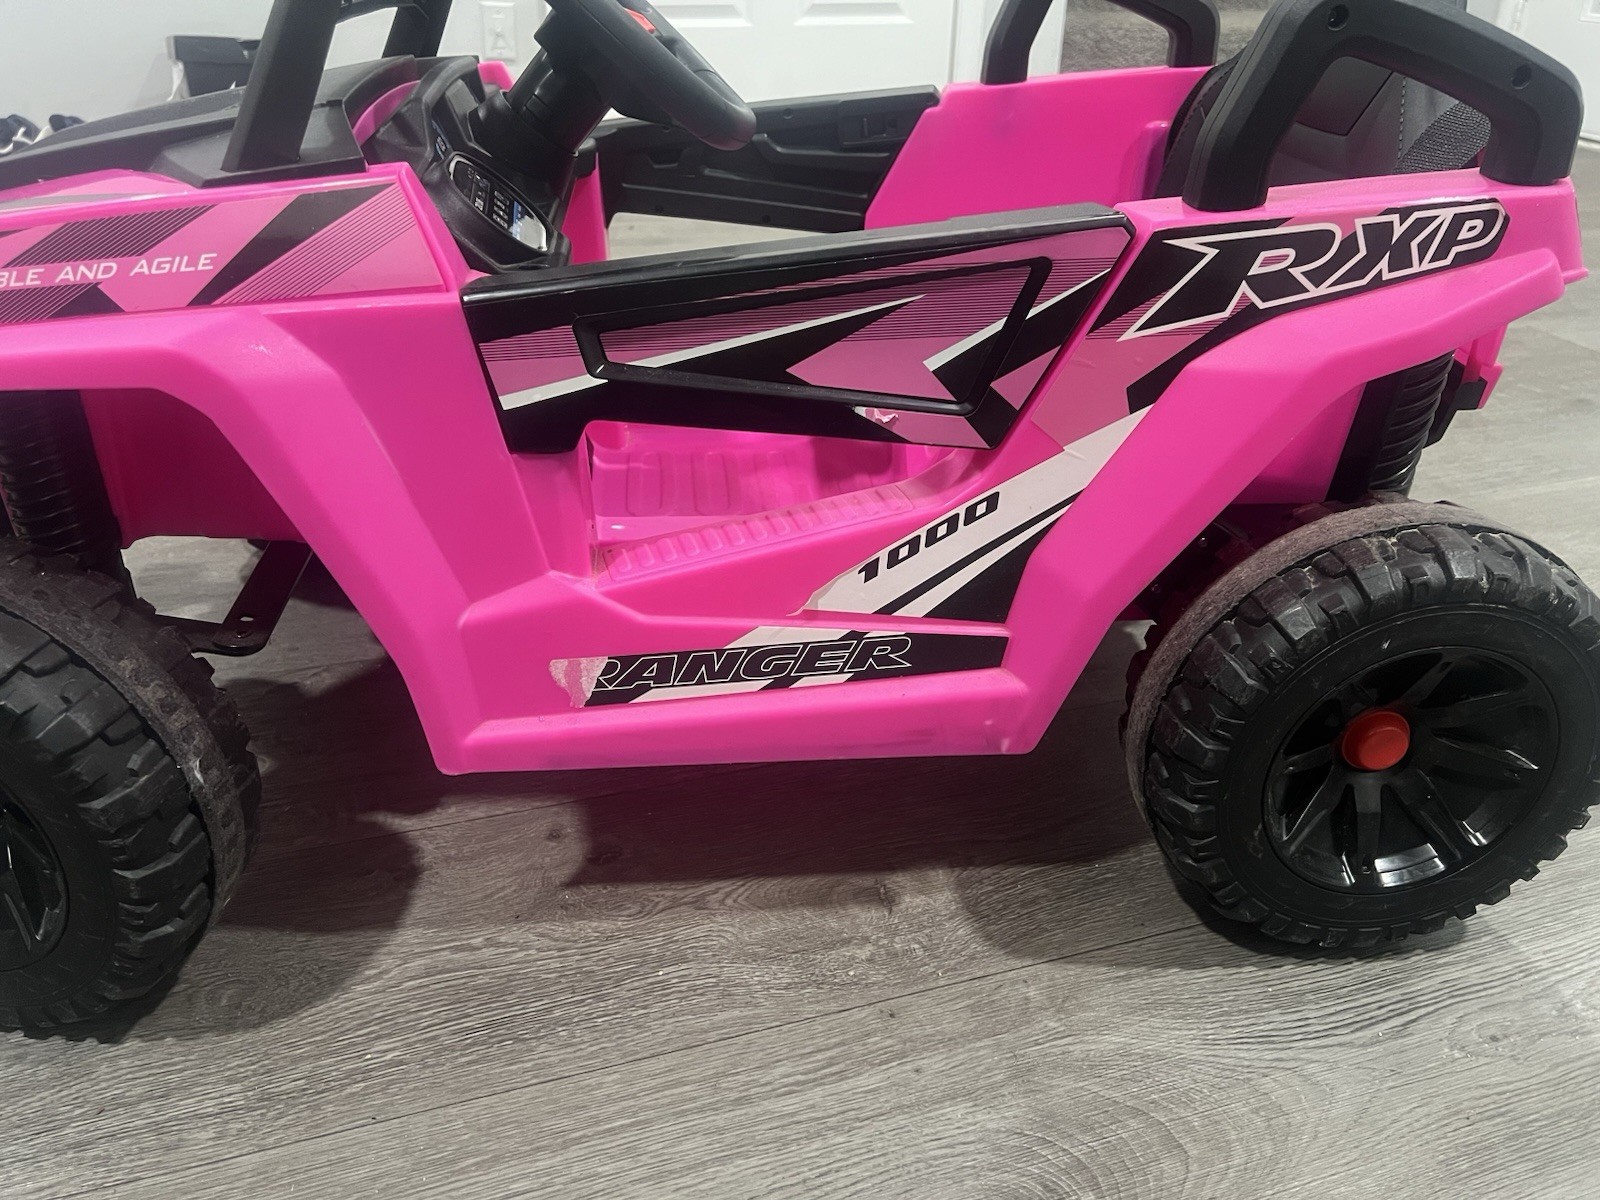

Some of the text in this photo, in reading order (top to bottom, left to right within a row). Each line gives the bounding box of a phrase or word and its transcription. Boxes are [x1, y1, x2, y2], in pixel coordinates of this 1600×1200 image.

[55, 262, 117, 283] AND
[129, 253, 218, 277] AGILE
[1116, 203, 1505, 343] RXP
[857, 491, 1000, 584] 1000
